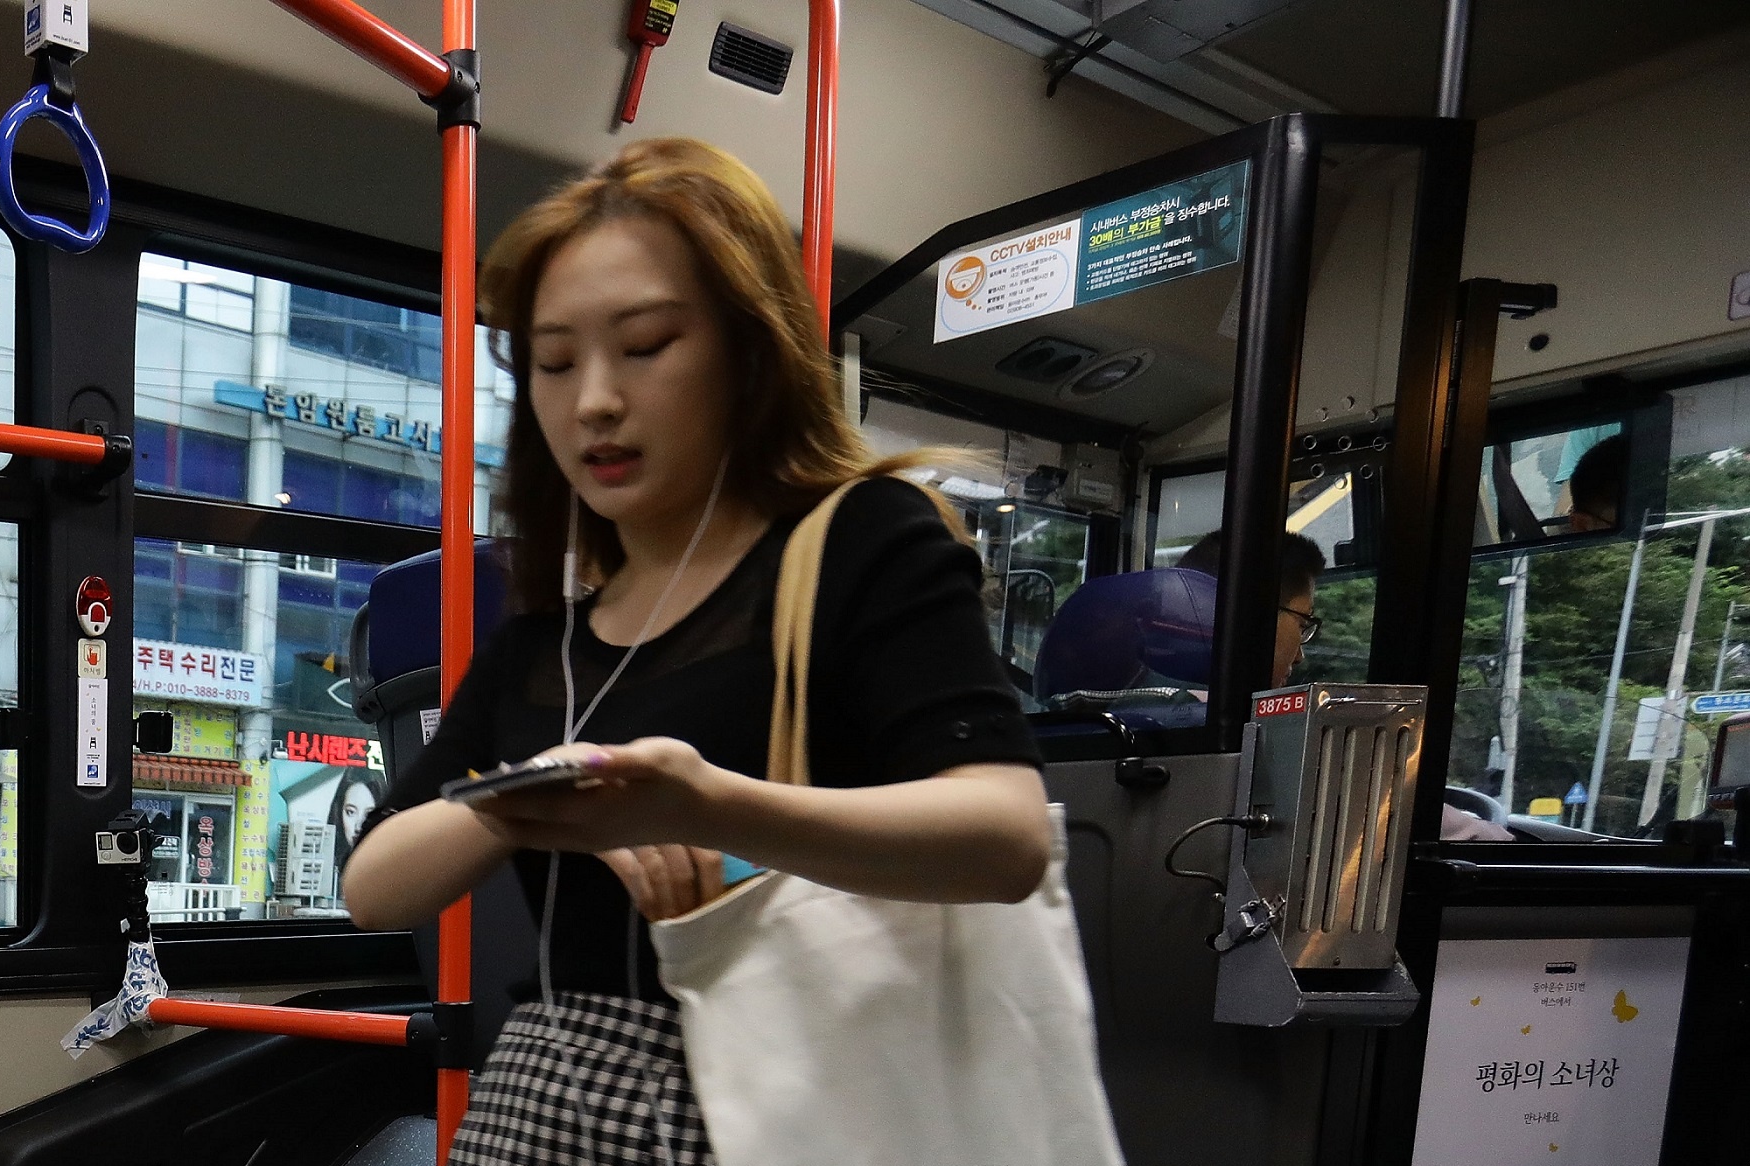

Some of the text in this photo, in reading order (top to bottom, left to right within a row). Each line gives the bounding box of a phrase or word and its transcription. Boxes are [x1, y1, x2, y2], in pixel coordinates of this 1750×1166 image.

[1089, 228, 1124, 247] 30배의
[1177, 195, 1230, 221] 징수합니다.
[1090, 196, 1181, 233] 시내버스 부정승차시
[990, 227, 1072, 263] CCTV설치안내
[264, 383, 441, 452] 돈암원룸고시
[1258, 696, 1304, 715] 3875 B
[1532, 982, 1586, 994] 동아운수 151번
[1540, 996, 1572, 1008] 버스에서
[1475, 1057, 1620, 1093] 평화의 소녀상
[1523, 1111, 1560, 1126] 만나세요
